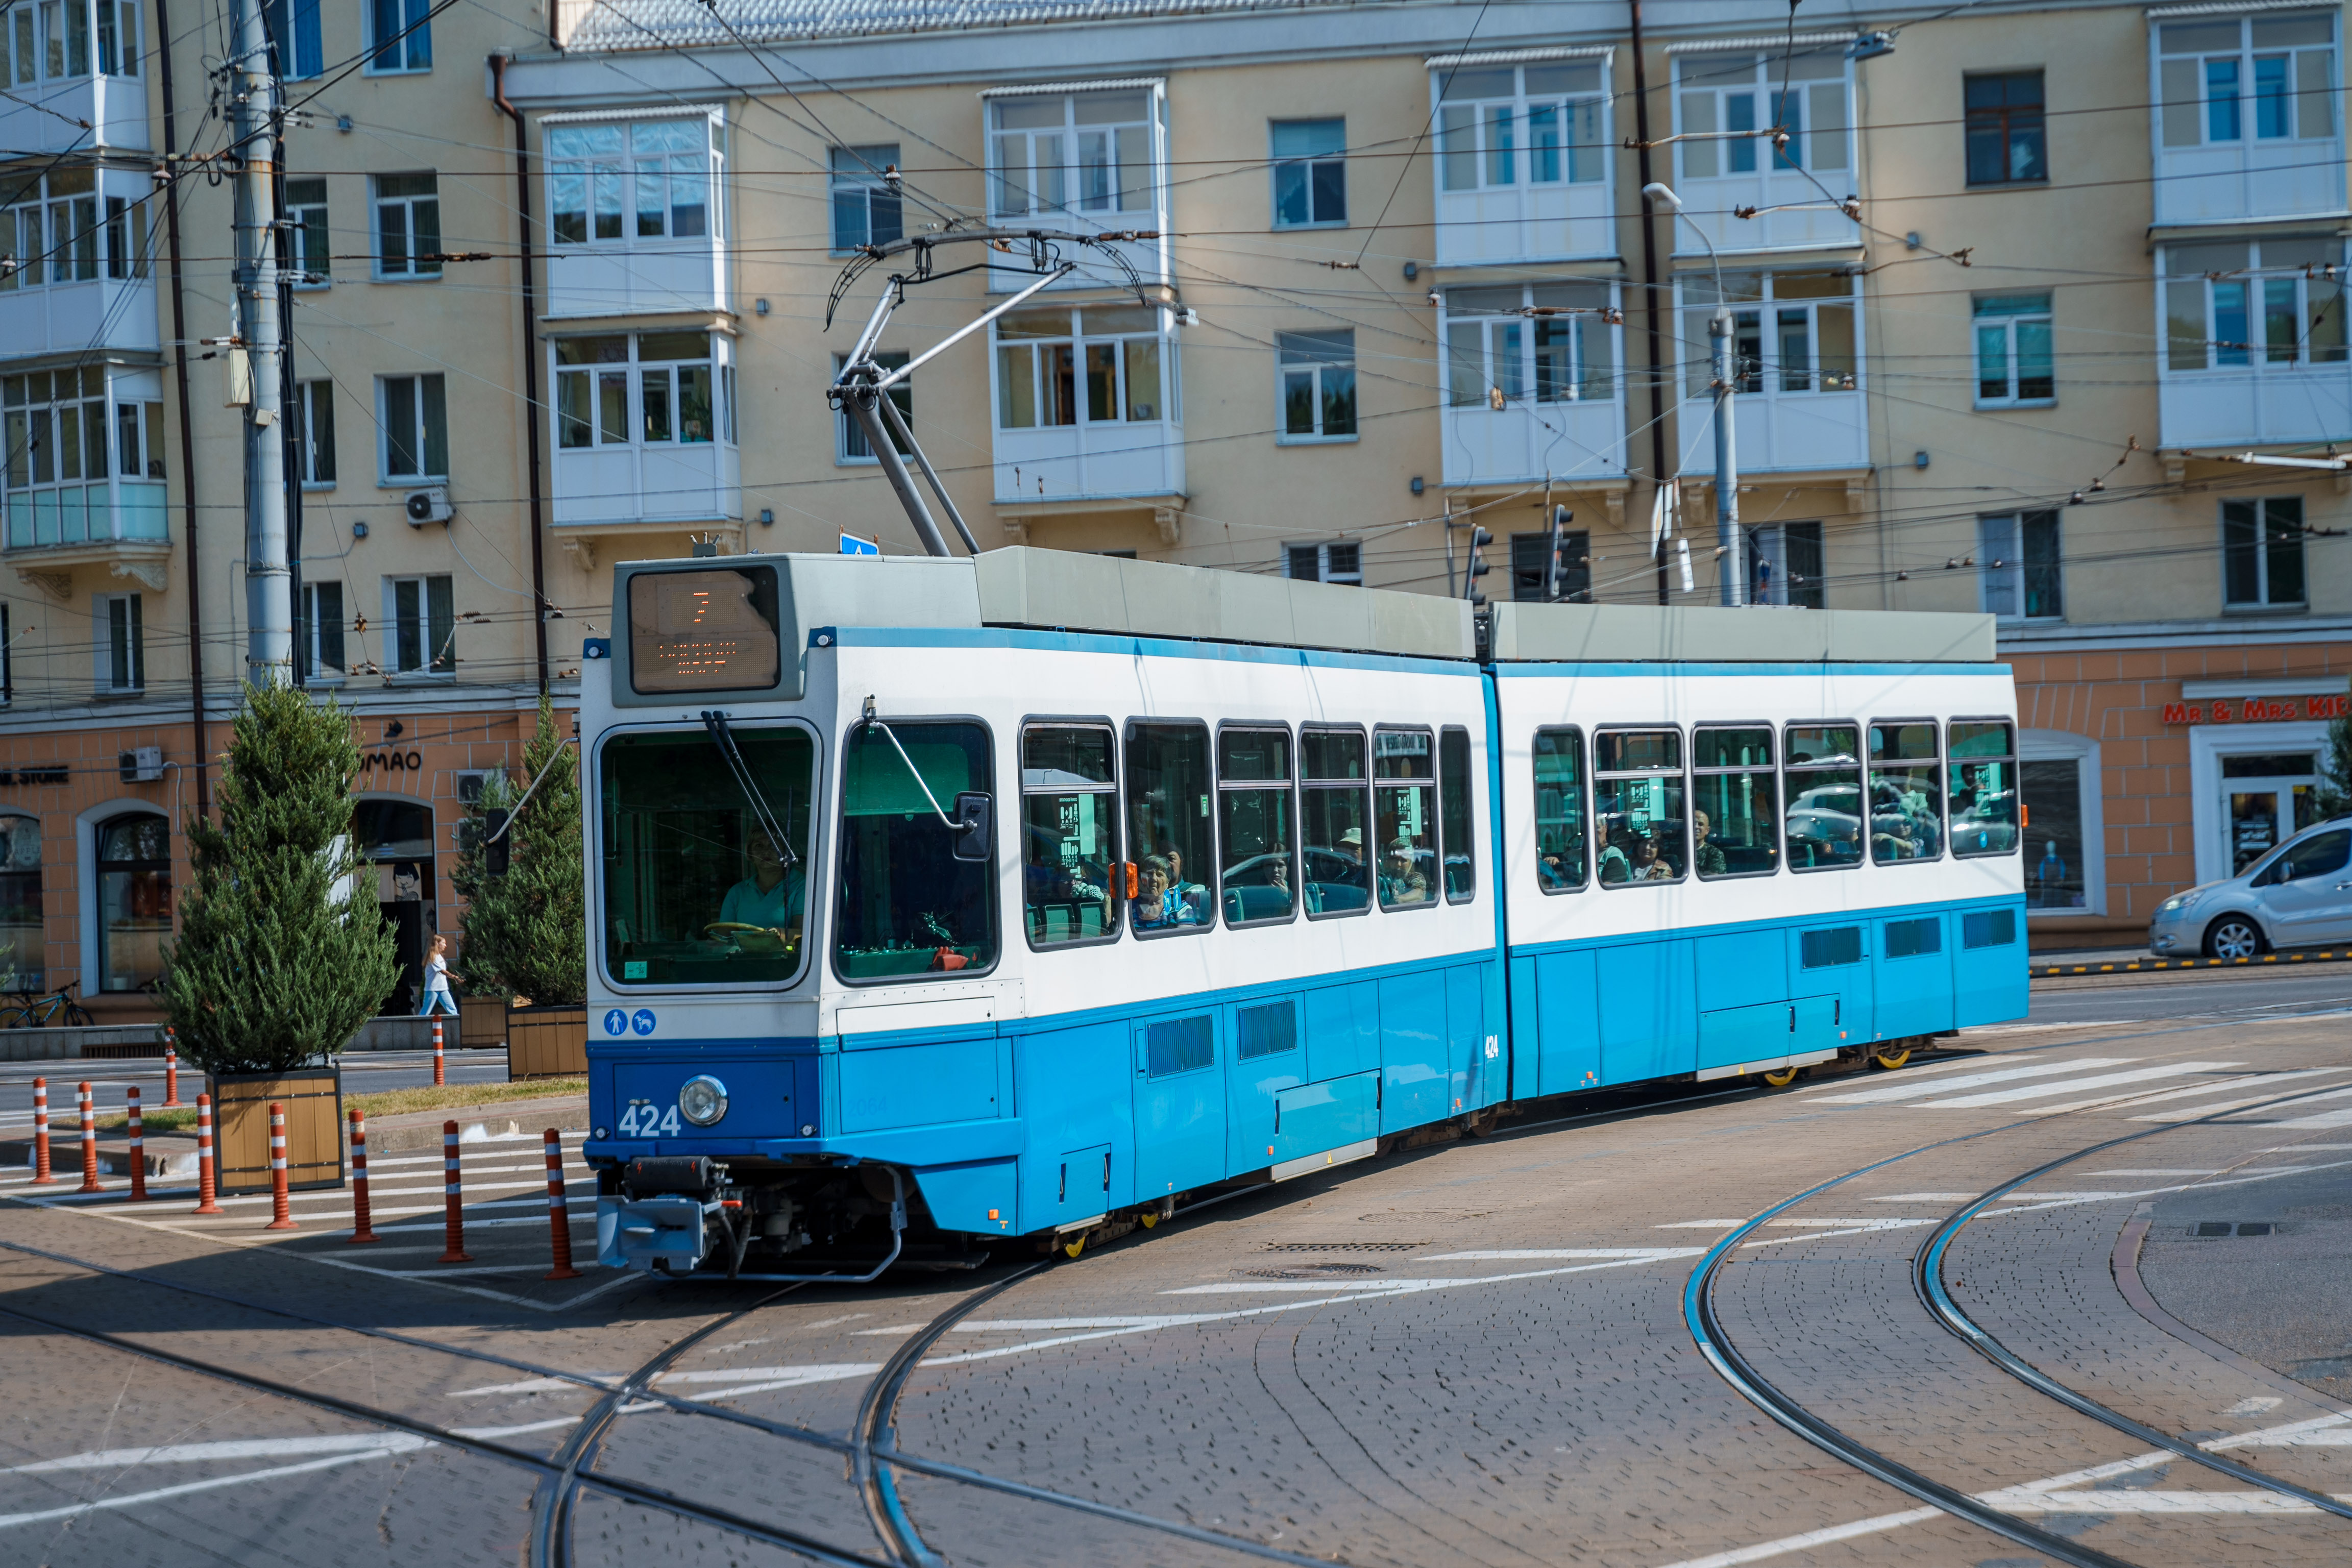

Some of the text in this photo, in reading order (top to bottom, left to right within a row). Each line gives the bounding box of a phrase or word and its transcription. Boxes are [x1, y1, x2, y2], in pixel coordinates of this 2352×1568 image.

[693, 592, 709, 623] 7
[2212, 699, 2234, 722] &
[1485, 1034, 1499, 1059] 424
[619, 1105, 681, 1137] 424
